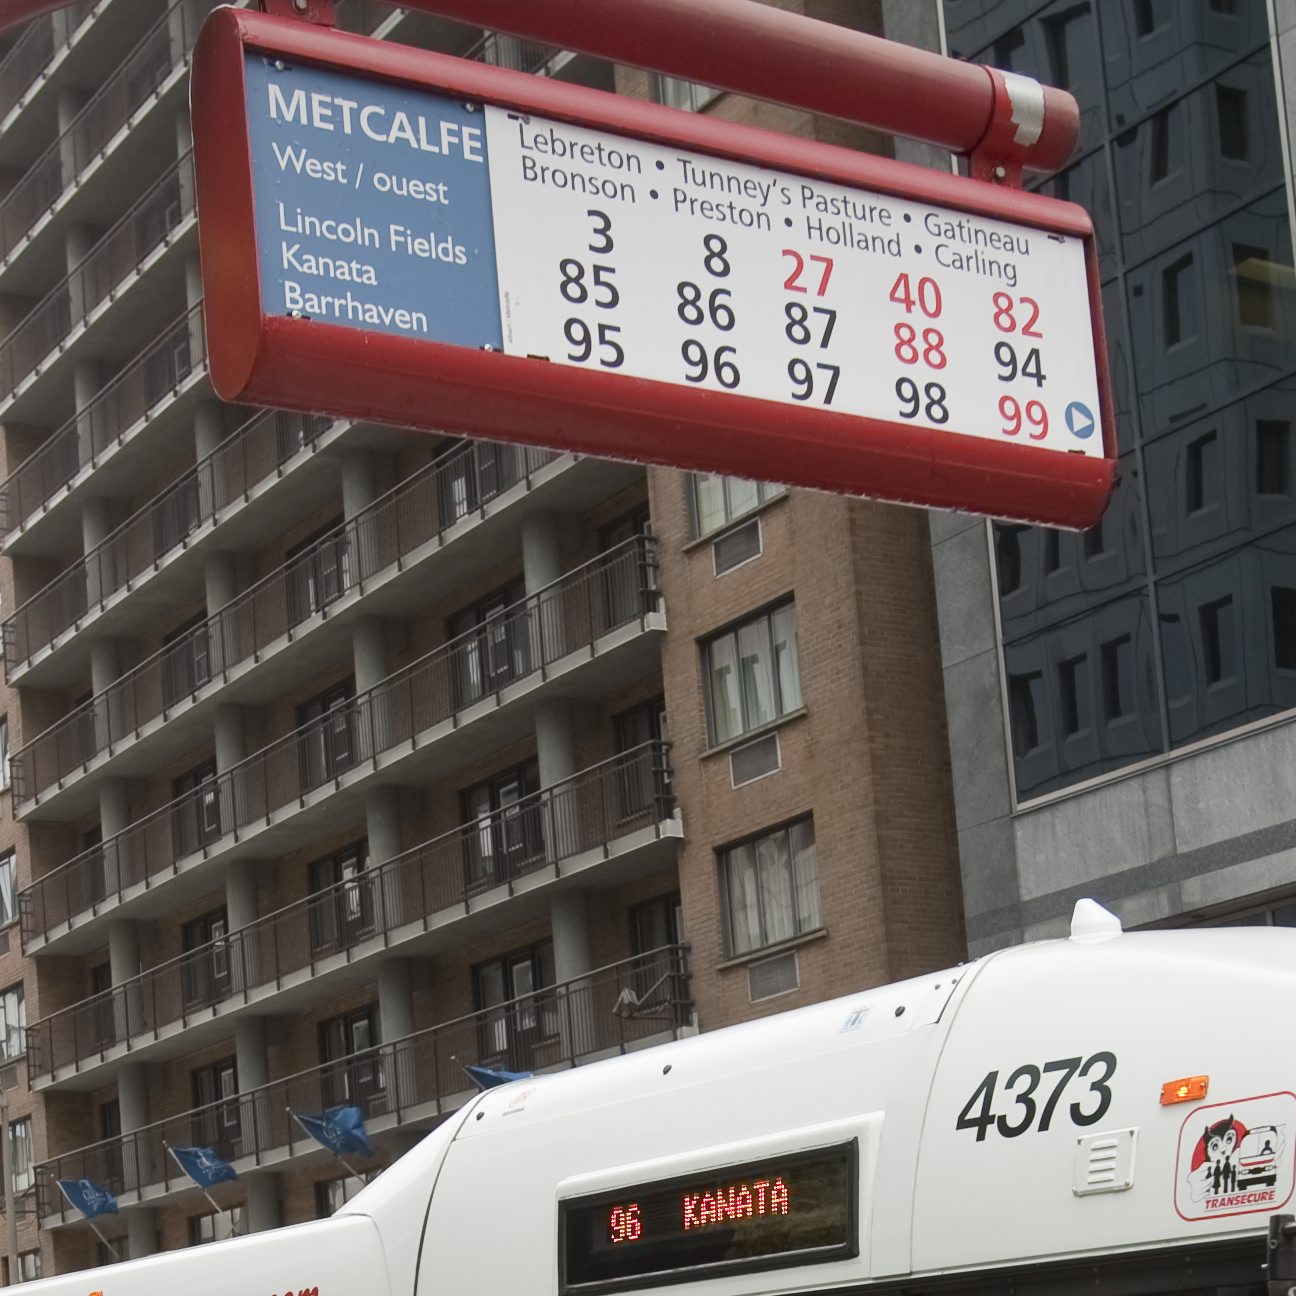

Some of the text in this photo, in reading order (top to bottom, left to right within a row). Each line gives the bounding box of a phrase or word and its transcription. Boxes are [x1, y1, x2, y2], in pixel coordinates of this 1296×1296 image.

[268, 83, 483, 163] METCALFE
[272, 142, 347, 184] West
[373, 171, 449, 204] ouest
[519, 123, 1030, 257] Lebreton Tunney's Pasture Gatineau
[279, 202, 467, 265] Lincoln Fields
[522, 155, 1017, 288] Bronson Preston Holland Carling
[281, 241, 378, 286] Kanata
[587, 209, 1043, 339] 3 8 27 40 82
[284, 280, 428, 333] Barrhaven
[559, 258, 1047, 387] 85 86 87 88 94
[563, 317, 1049, 440] 95 96 97 98 99
[957, 1051, 1117, 1142] 4373
[610, 1177, 789, 1243] 96 KANATA
[1203, 1190, 1276, 1210] TRANSECURE
